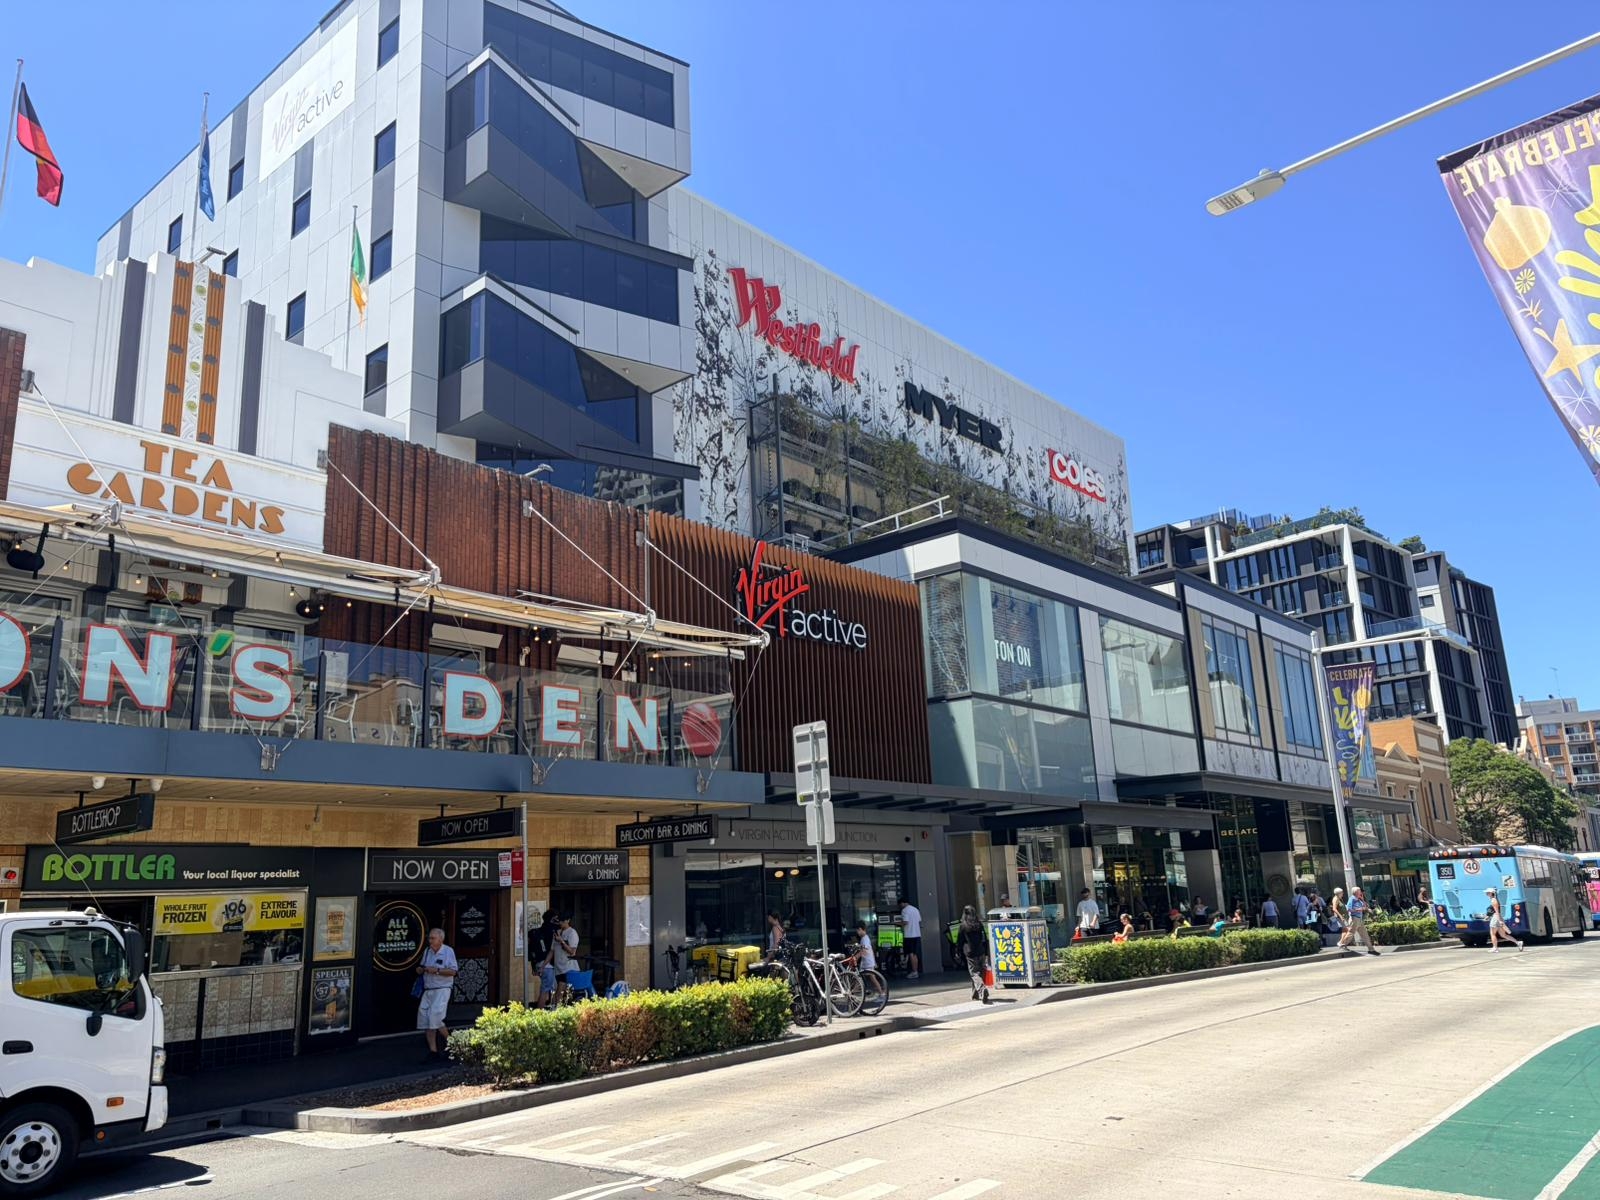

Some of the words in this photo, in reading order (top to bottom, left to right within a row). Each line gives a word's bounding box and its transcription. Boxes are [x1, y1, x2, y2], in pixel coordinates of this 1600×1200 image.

[297, 80, 344, 133] active
[726, 267, 861, 384] Westfield
[904, 381, 1004, 455] MYER
[140, 440, 233, 491] TEA
[1052, 453, 1106, 497] coles
[66, 463, 285, 534] GARDENS
[737, 540, 810, 637] Virgin
[791, 609, 867, 648] active
[1016, 644, 1032, 668] ON
[444, 671, 661, 752] DEN
[71, 805, 121, 833] BOTTLESHOP
[441, 821, 461, 837] NOW
[464, 817, 489, 834] OPEN
[620, 826, 655, 842] BALCONY
[657, 825, 673, 839] BAR
[674, 826, 681, 836] &
[682, 821, 708, 835] DINING
[738, 828, 771, 841] VIRGIN
[836, 832, 878, 842] JUNCTION
[42, 853, 176, 881] BOTTLER
[182, 869, 205, 880] Your
[206, 869, 230, 880] local
[231, 869, 258, 881] liquor
[260, 868, 300, 880] specialist
[393, 859, 435, 880] NOW
[442, 859, 489, 880] OPEN
[566, 854, 602, 865] BALCONY
[604, 854, 619, 865] BAR
[1466, 862, 1478, 871] 40
[588, 870, 594, 880] &
[596, 868, 620, 880] DINING
[163, 904, 189, 912] WHOLE
[188, 903, 208, 911] FRUIT
[260, 909, 297, 920] FLAVOUR
[261, 900, 297, 910] EXTREME
[162, 911, 207, 924] FROZEN
[388, 917, 408, 929] ALL
[316, 969, 350, 980] SPECIAL
